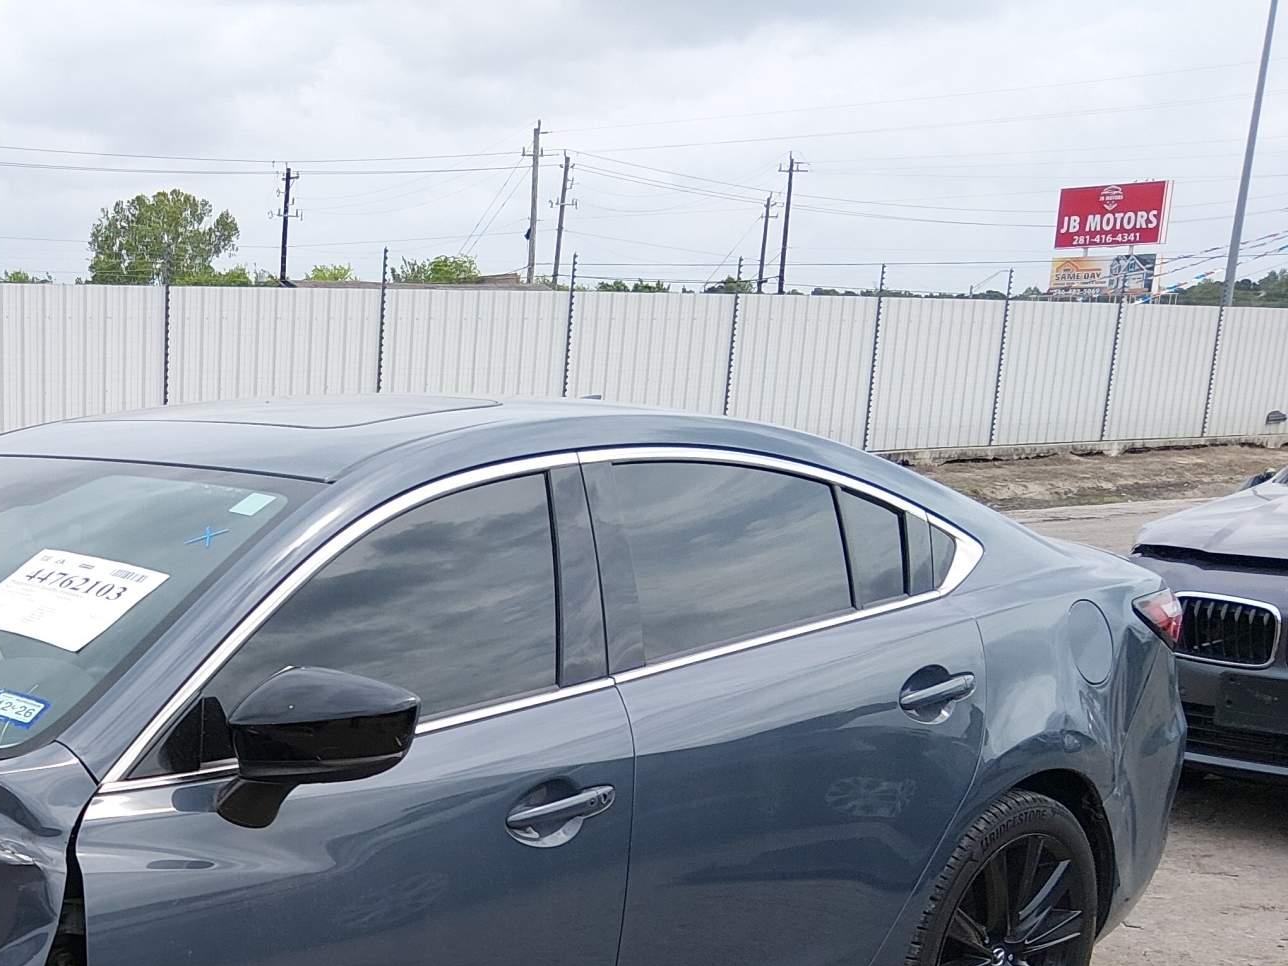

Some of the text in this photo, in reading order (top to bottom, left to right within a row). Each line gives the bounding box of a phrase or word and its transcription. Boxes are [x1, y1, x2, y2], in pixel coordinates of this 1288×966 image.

[1060, 210, 1158, 234] JB MOTORS
[1072, 233, 1140, 245] 281-416-4341
[1055, 271, 1102, 281] SAME DAY
[25, 568, 128, 601] 44762103
